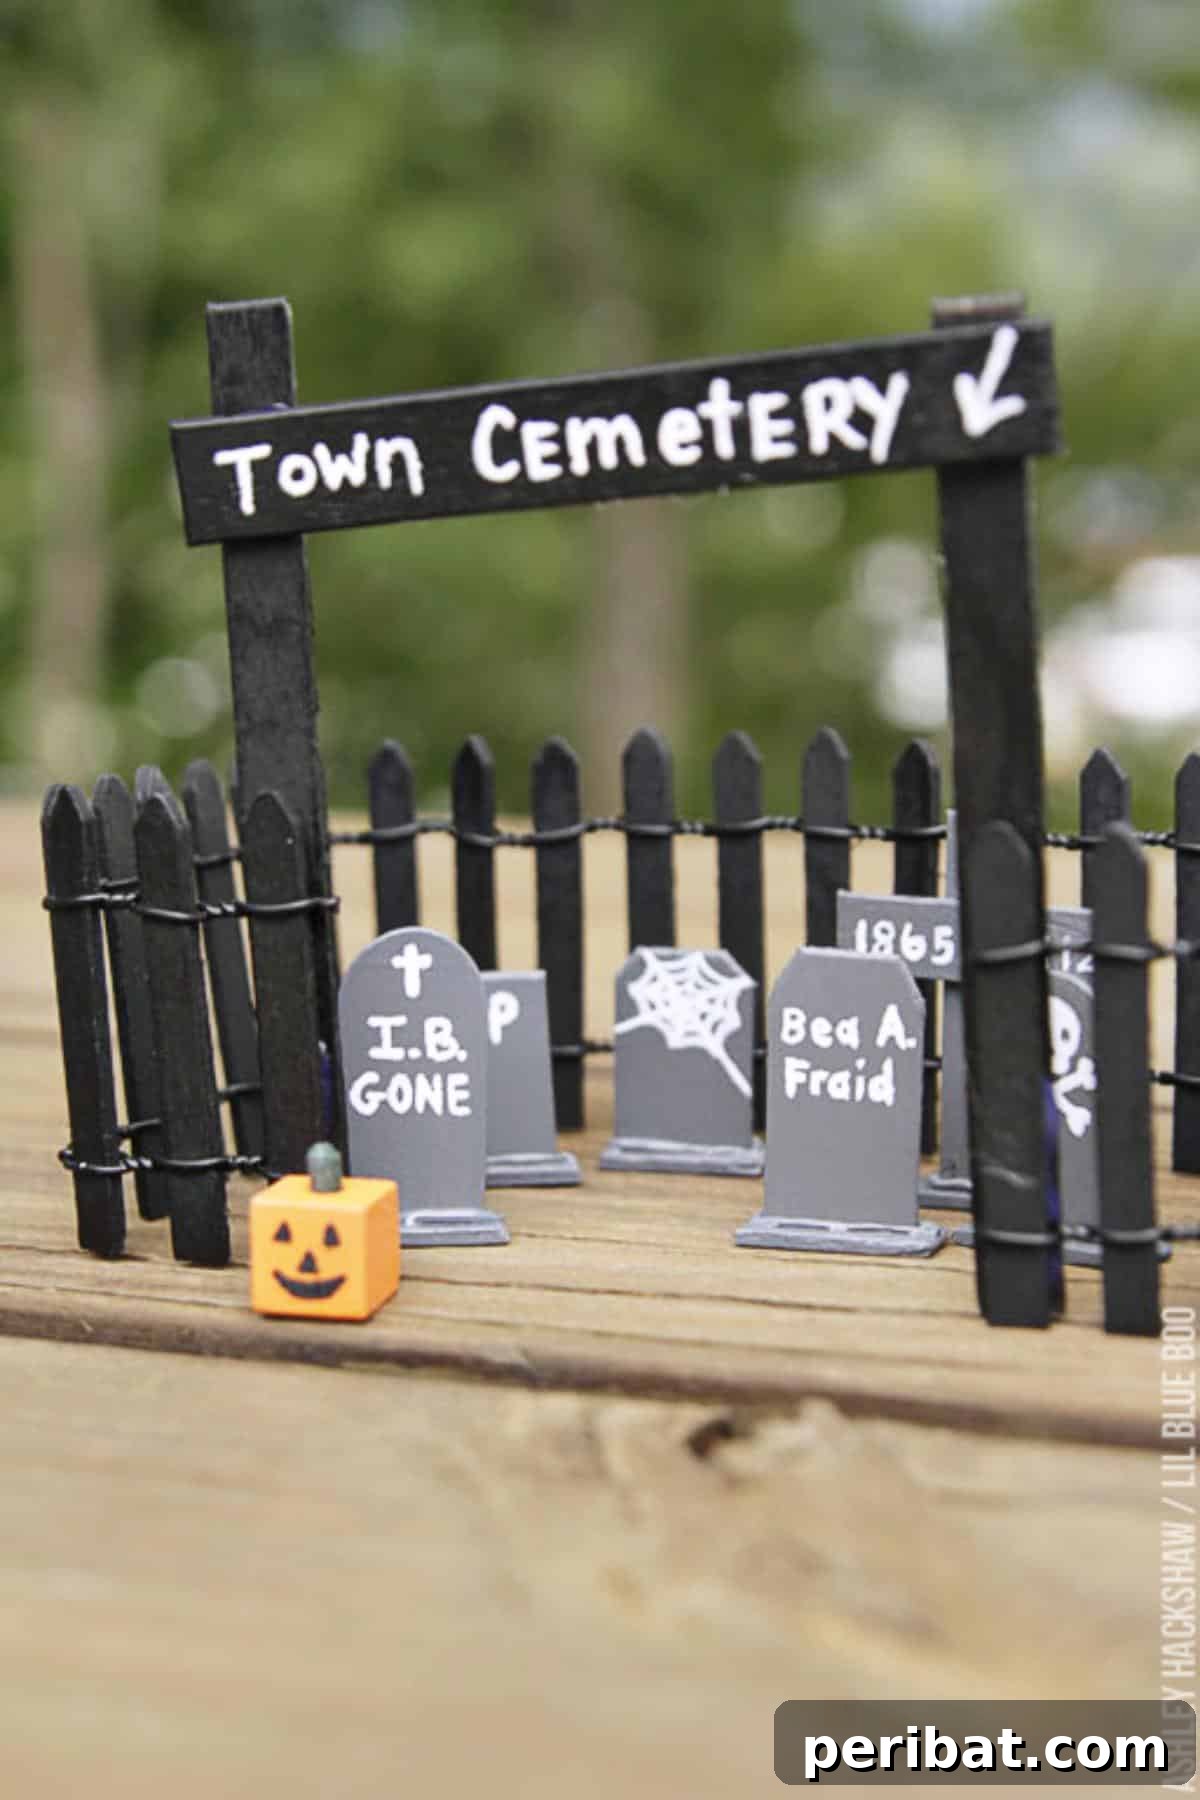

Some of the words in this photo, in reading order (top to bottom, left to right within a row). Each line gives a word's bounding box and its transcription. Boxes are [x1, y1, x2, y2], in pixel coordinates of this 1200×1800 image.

[213, 432, 425, 516] Town
[855, 918, 955, 967] 1865
[366, 1014, 468, 1063] I.B.
[780, 1007, 860, 1050] Bea
[875, 1003, 917, 1051] A.
[349, 1071, 472, 1117] GONE
[784, 1056, 896, 1107] Fraid
